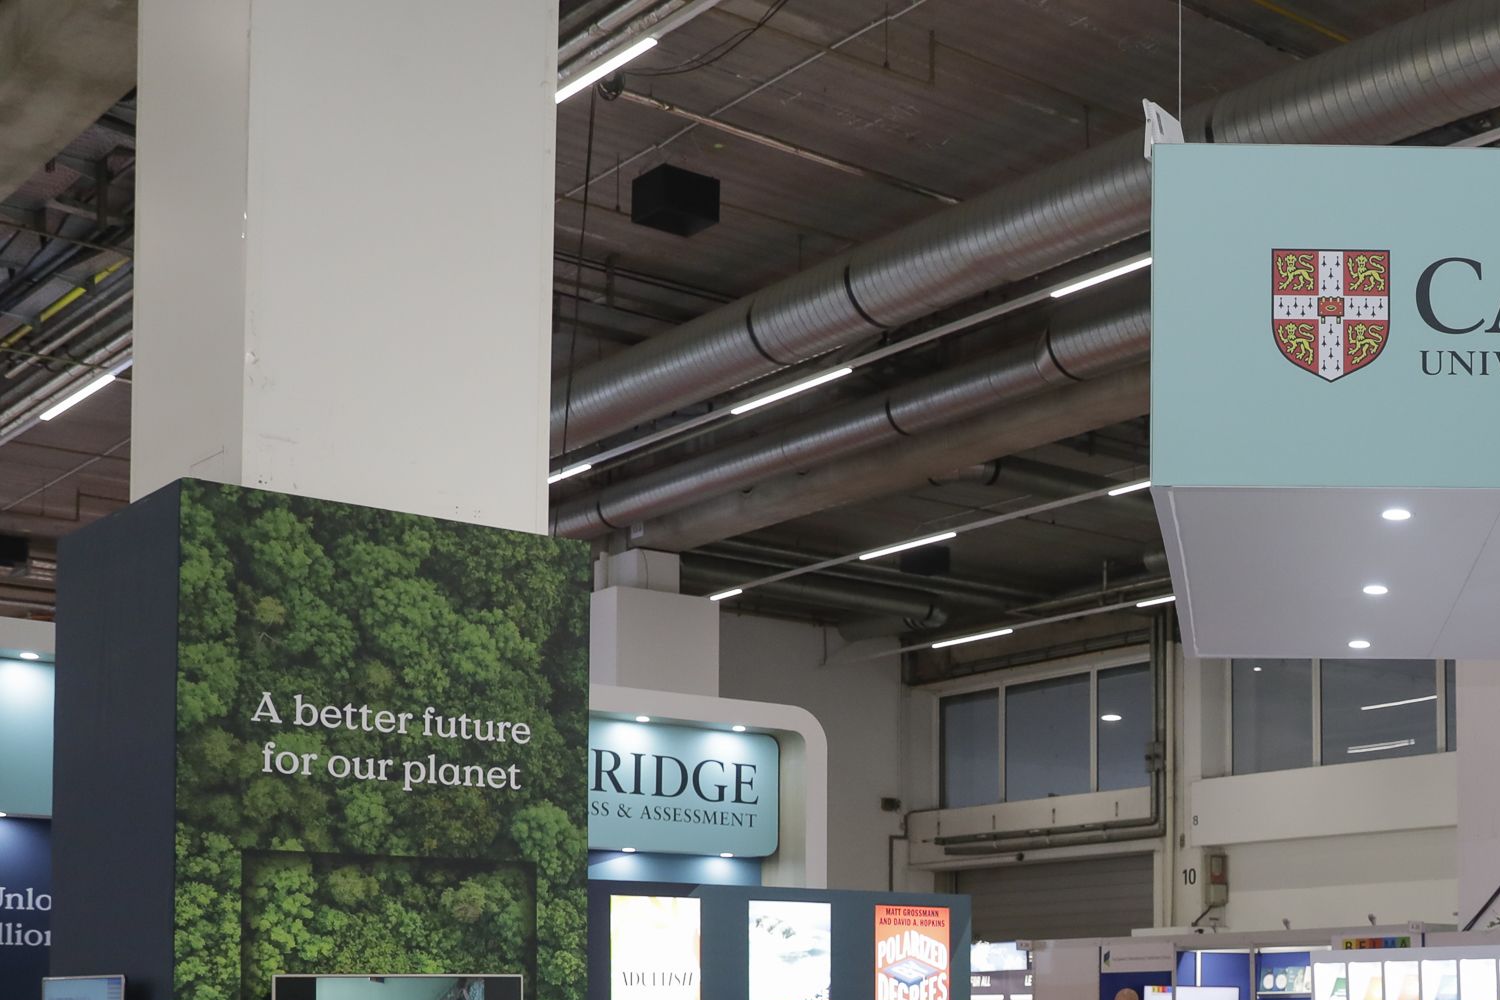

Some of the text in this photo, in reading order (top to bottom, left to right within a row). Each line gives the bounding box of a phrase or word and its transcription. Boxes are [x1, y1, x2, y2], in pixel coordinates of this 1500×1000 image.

[250, 692, 531, 744] A better future
[261, 742, 522, 791] for our planet
[590, 749, 759, 805] RIDGE
[588, 801, 758, 828] SS & ASSESSMENT
[1182, 868, 1197, 886] 10
[0, 887, 52, 911] nlo
[886, 908, 939, 917] MATT GROSSMANN
[879, 918, 892, 926] AND
[893, 918, 911, 926] DAVID
[920, 919, 945, 927] HOPKINS
[878, 930, 948, 971] POLARIZED
